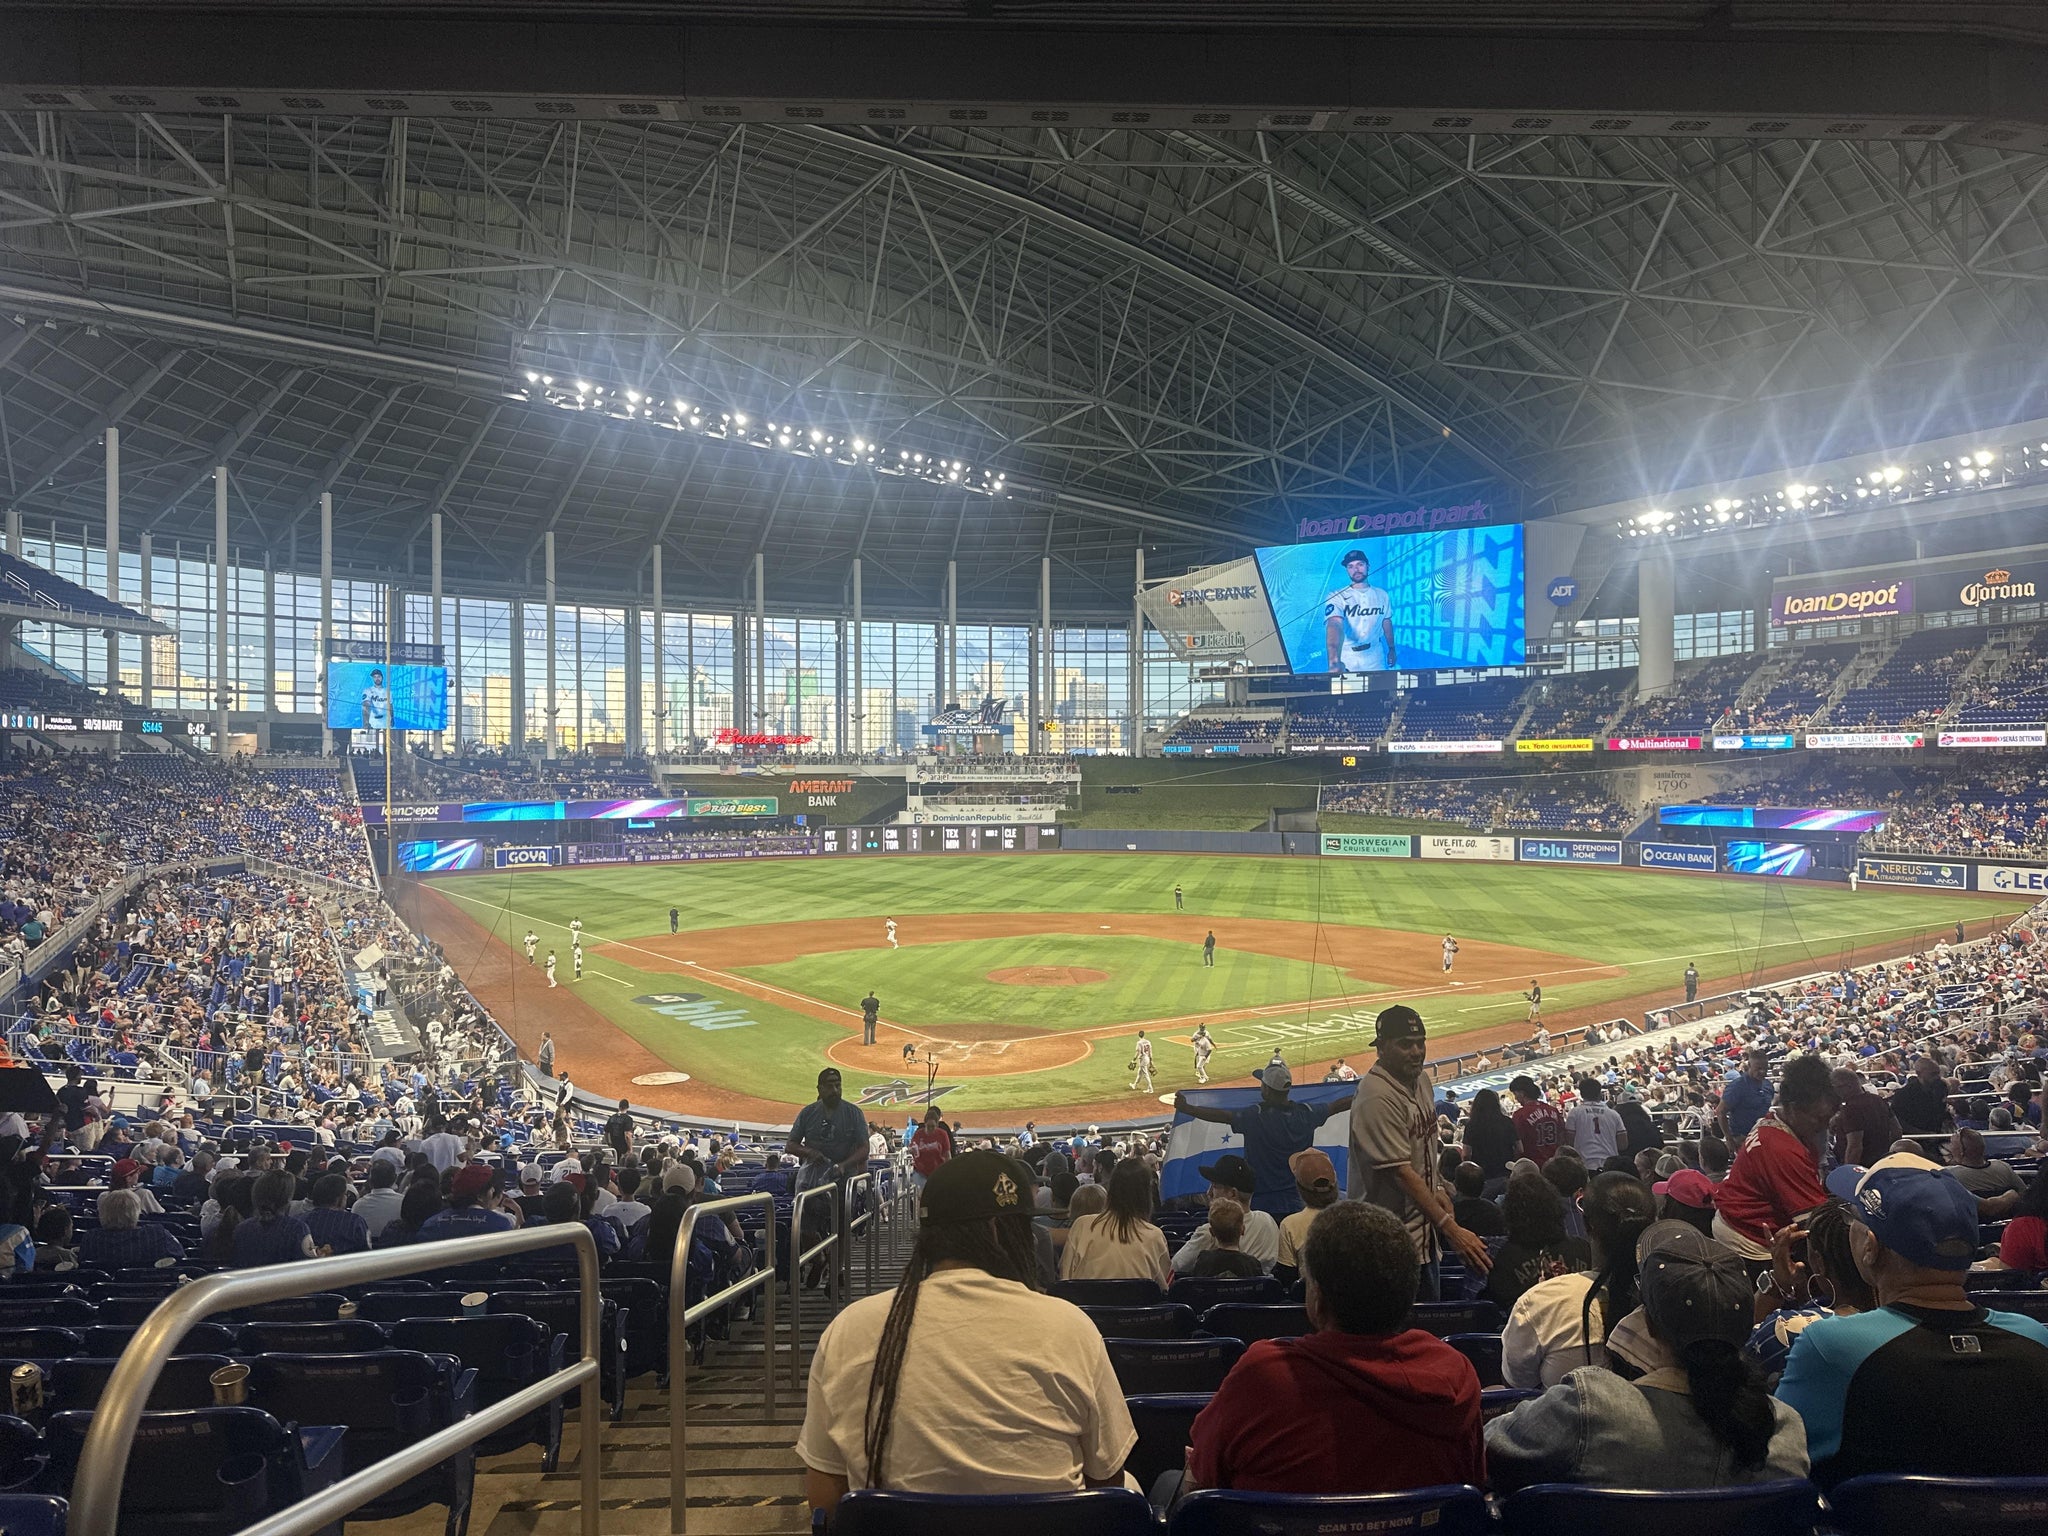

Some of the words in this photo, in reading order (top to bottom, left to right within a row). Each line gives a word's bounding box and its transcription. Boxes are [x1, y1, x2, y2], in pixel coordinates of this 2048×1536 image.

[1299, 506, 1428, 537] loanDepot
[1428, 499, 1489, 529] park
[1550, 585, 1575, 598] ADT
[1960, 582, 2036, 607] Corona
[1783, 584, 1899, 615] loanDepot
[1343, 604, 1384, 617] Miami
[83, 718, 102, 730] 50/50
[102, 719, 123, 732] RAFFLE
[142, 722, 163, 733] $5445
[188, 723, 206, 736] 6:42
[713, 728, 814, 745] Budweiser
[1630, 740, 1689, 749] Multinational
[930, 774, 949, 784] arajet
[789, 780, 852, 794] AMERANT
[1657, 780, 1688, 793] 1796
[808, 796, 837, 806] BANK
[711, 805, 736, 814] Baja
[736, 804, 767, 812] Blast
[824, 830, 836, 840] PIT
[852, 830, 857, 840] 3
[885, 830, 898, 840] CIN
[912, 829, 918, 838] 5
[946, 828, 958, 838] TEX
[971, 828, 976, 838] 4
[1004, 828, 1016, 838] CLE
[824, 840, 838, 852] DET
[851, 840, 857, 851] 4
[885, 840, 899, 850] TOR
[1004, 840, 1014, 848] KC
[1344, 838, 1406, 846] NORWEGIAN
[1432, 838, 1450, 847] LIVE.
[1452, 839, 1464, 848] FIT.
[1466, 840, 1478, 848] GO.
[508, 850, 547, 862] GOYA
[1539, 843, 1568, 858] blu
[1572, 844, 1617, 852] DEFENDING
[1655, 851, 1686, 862] OCEAN
[1687, 853, 1712, 864] BANK
[2014, 872, 2048, 890] LE
[1592, 1117, 1600, 1134] 1
[1536, 1121, 1558, 1146] 13
[996, 1180, 1014, 1194] 42
[165, 1426, 186, 1434] NOW
[1318, 1522, 1348, 1533] SCAN
[1350, 1522, 1364, 1532] TO
[1366, 1520, 1387, 1530] BET
[1388, 1516, 1414, 1528] NOW
